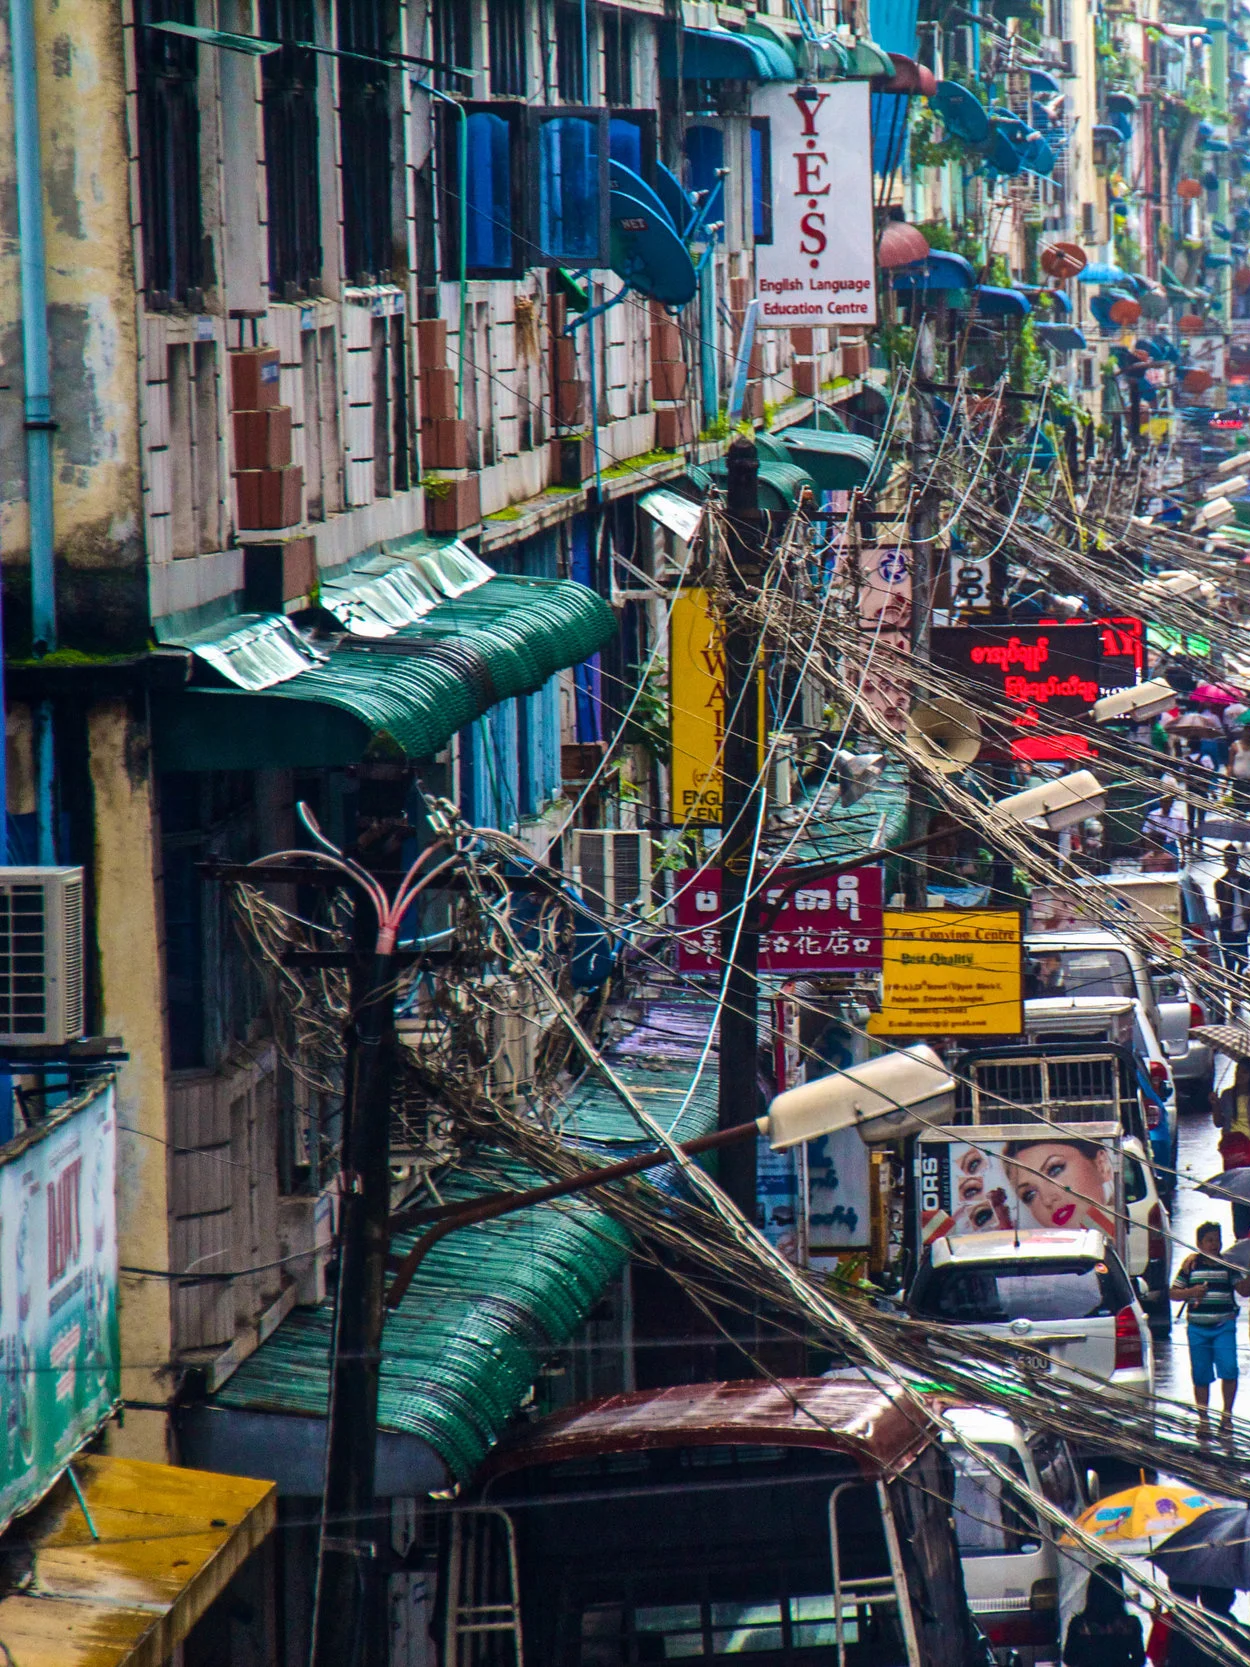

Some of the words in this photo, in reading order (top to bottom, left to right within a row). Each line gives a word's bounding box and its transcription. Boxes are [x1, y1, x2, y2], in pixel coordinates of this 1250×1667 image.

[759, 278, 804, 295] English
[809, 278, 871, 294] Language
[763, 302, 823, 316] Education
[827, 301, 869, 315] Centre
[792, 926, 851, 956] 花店
